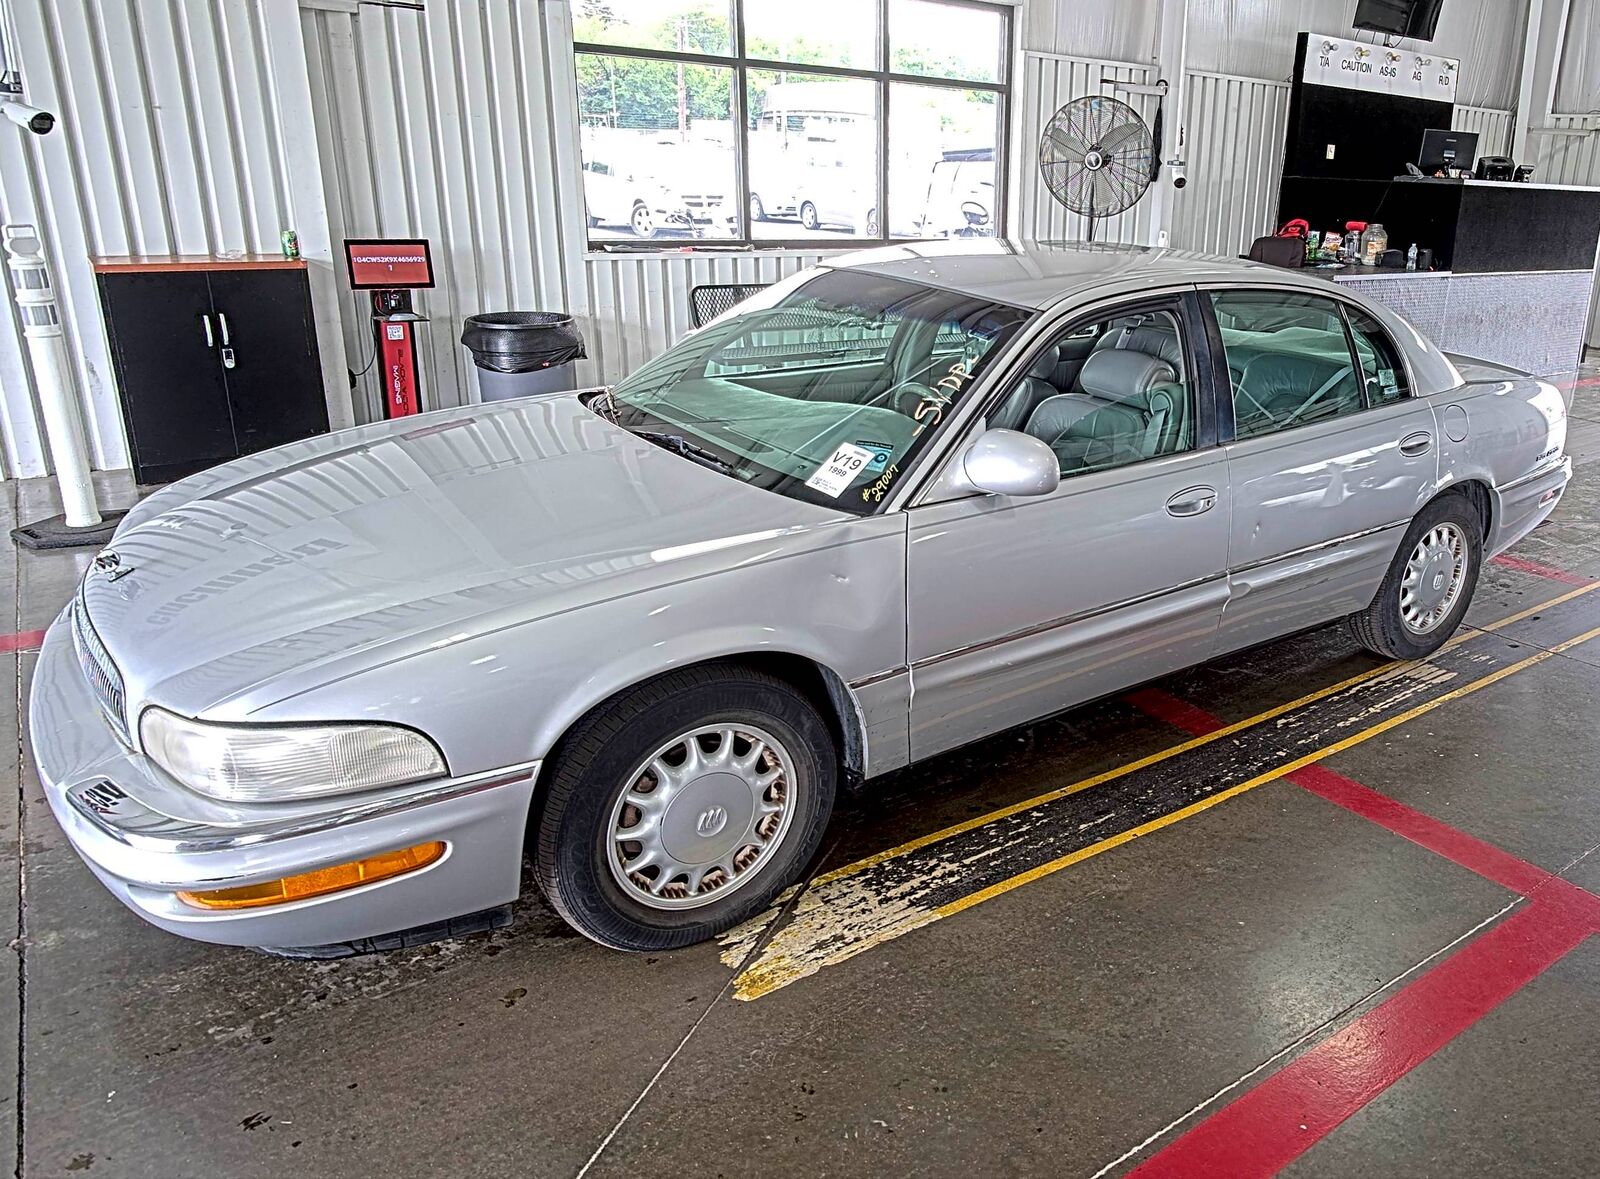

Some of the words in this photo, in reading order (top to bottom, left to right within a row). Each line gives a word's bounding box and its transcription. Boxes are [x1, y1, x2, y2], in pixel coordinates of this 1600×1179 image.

[1319, 55, 1330, 68] T/A
[1341, 59, 1373, 74] CAUTION
[1412, 71, 1423, 81] AG
[392, 365, 403, 404] IMAGING
[832, 451, 863, 471] V19
[827, 465, 848, 477] 1999
